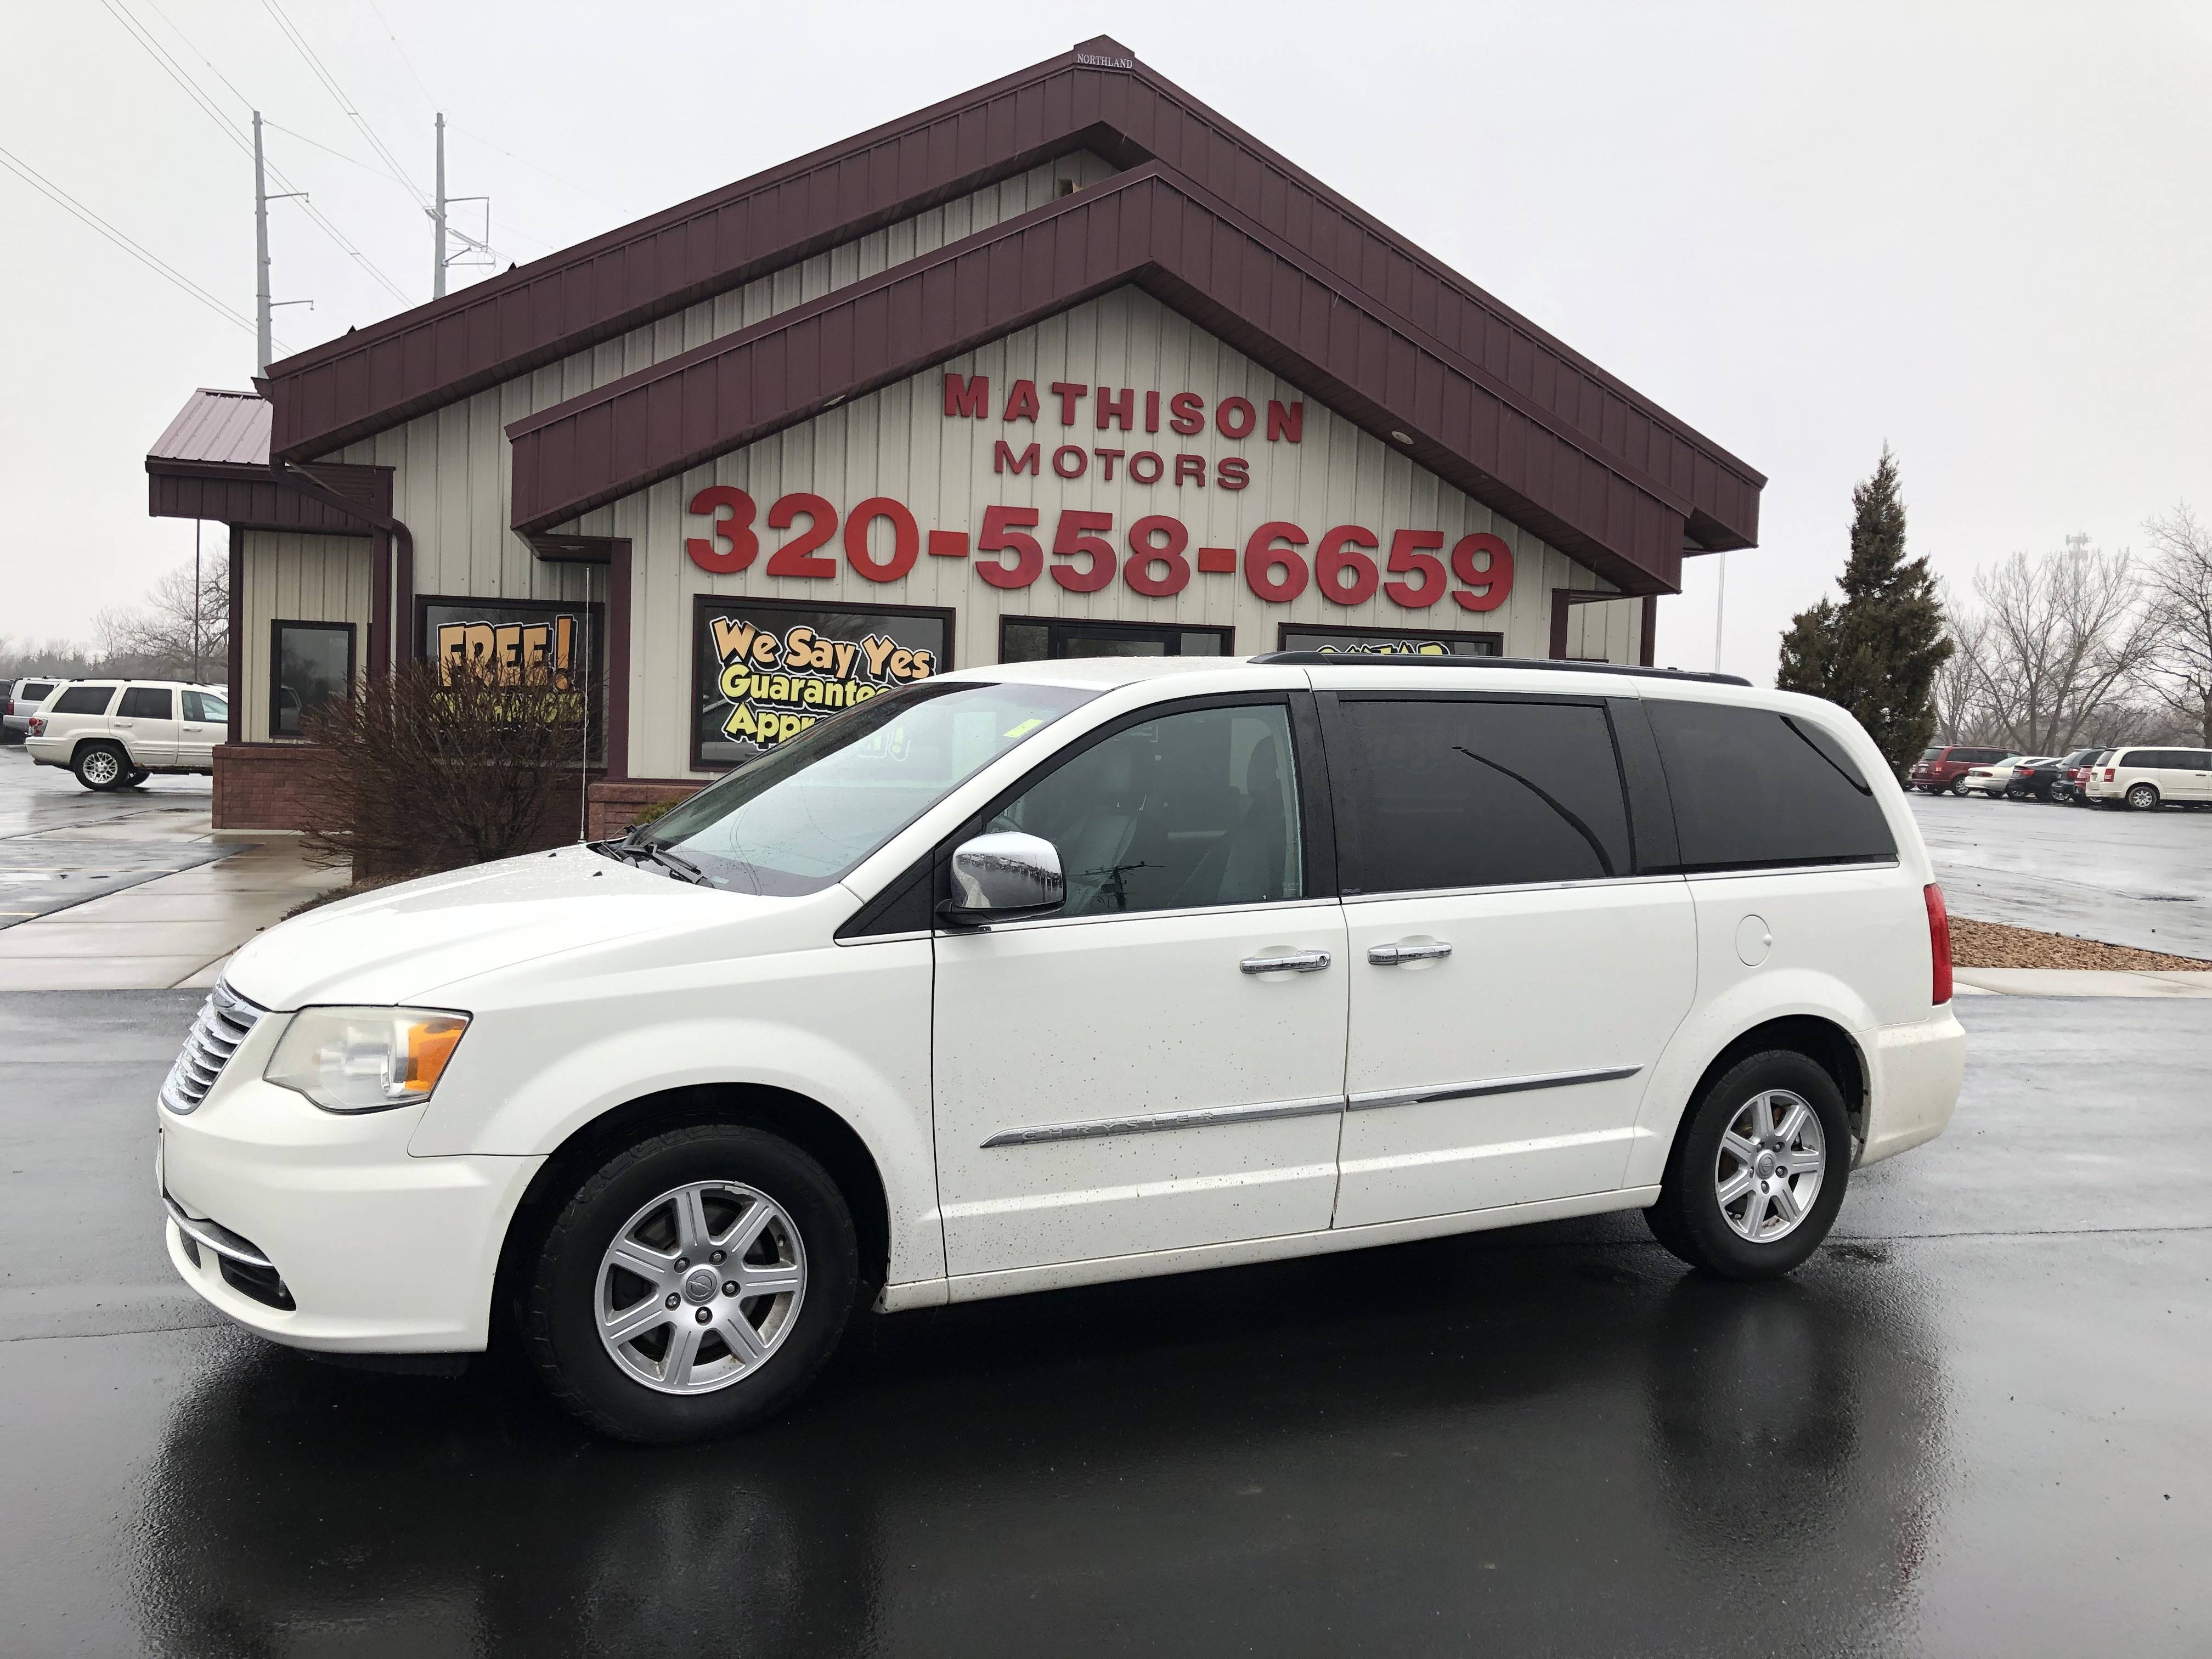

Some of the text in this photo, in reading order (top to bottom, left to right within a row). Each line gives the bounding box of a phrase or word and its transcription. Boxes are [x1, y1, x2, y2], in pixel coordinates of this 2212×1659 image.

[1077, 54, 1133, 69] NORTHLAND
[945, 373, 1303, 443] MATHISON
[995, 440, 1250, 490] MOTORS
[686, 485, 1514, 613] 320-558-6659
[438, 617, 572, 690] FREE!
[712, 618, 934, 680] We Say Yes
